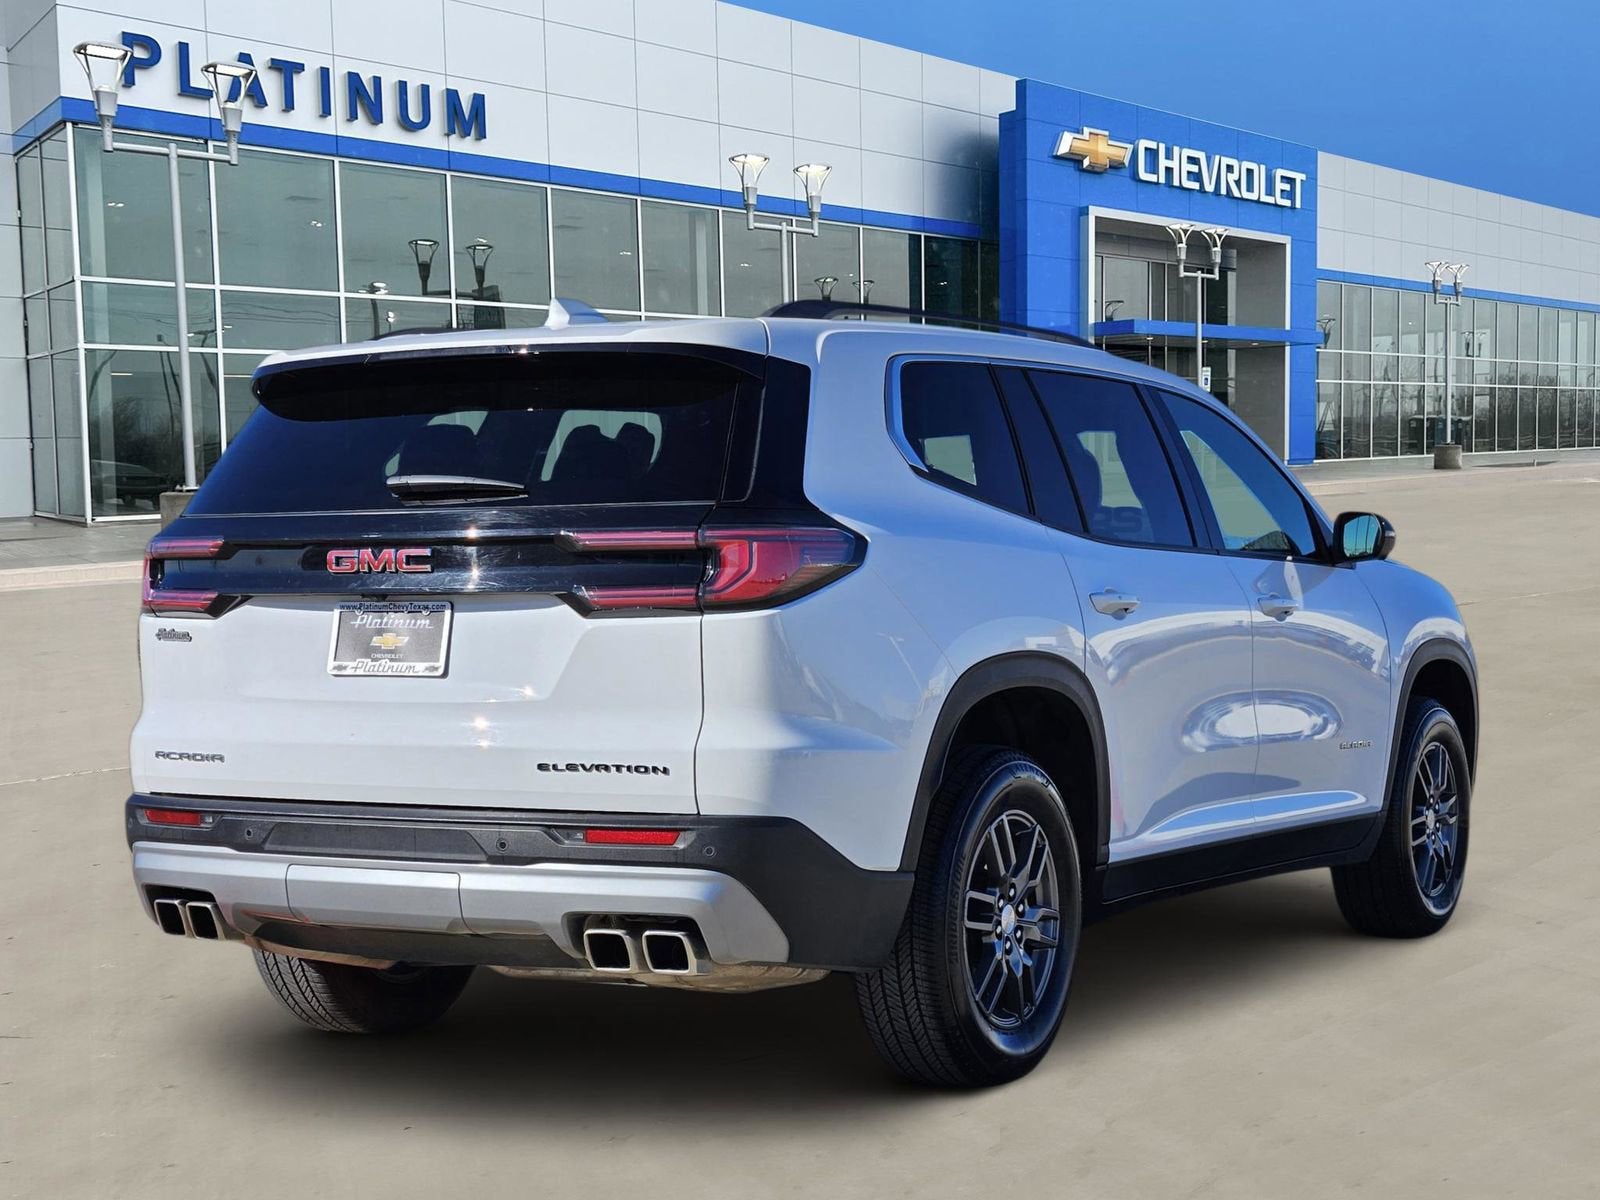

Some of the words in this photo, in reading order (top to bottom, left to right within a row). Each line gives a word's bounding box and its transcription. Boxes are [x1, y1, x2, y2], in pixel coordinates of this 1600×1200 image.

[121, 31, 486, 140] PLATINUM
[1135, 139, 1306, 208] CHEVROLET
[326, 548, 432, 573] GMC
[340, 602, 447, 613] www.PlatinumChevyTexas.com
[350, 614, 434, 629] Platinum
[350, 660, 420, 673] Platinum
[155, 751, 225, 763] ACADIA
[536, 763, 671, 776] ELEVATION
